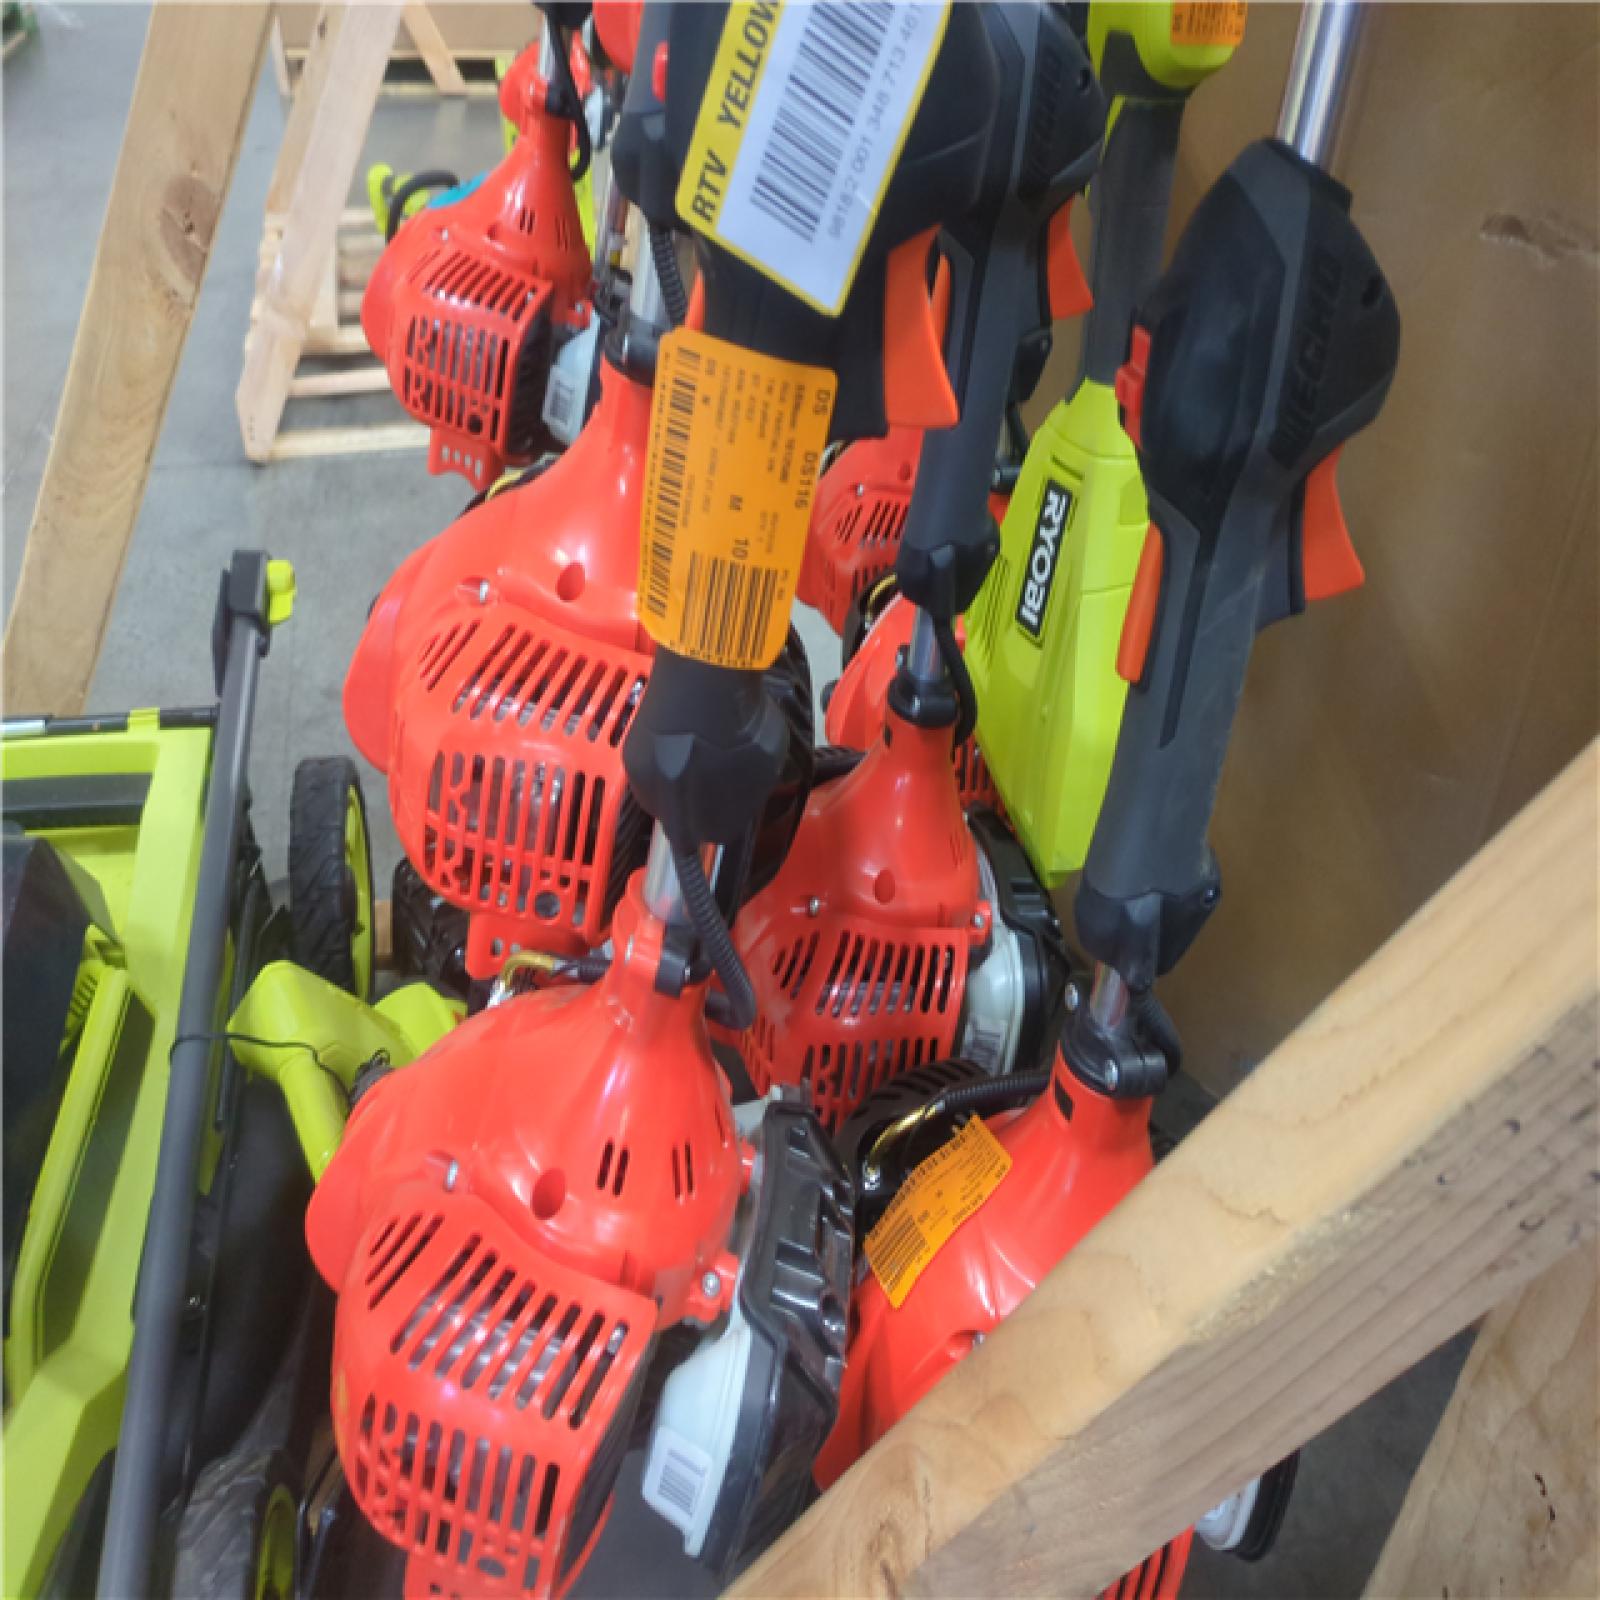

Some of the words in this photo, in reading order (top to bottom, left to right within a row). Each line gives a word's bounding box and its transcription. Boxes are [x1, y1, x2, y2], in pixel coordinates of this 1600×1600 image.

[691, 147, 726, 224] RTV
[731, 537, 749, 559] 10
[1020, 489, 1067, 626] RYOBI
